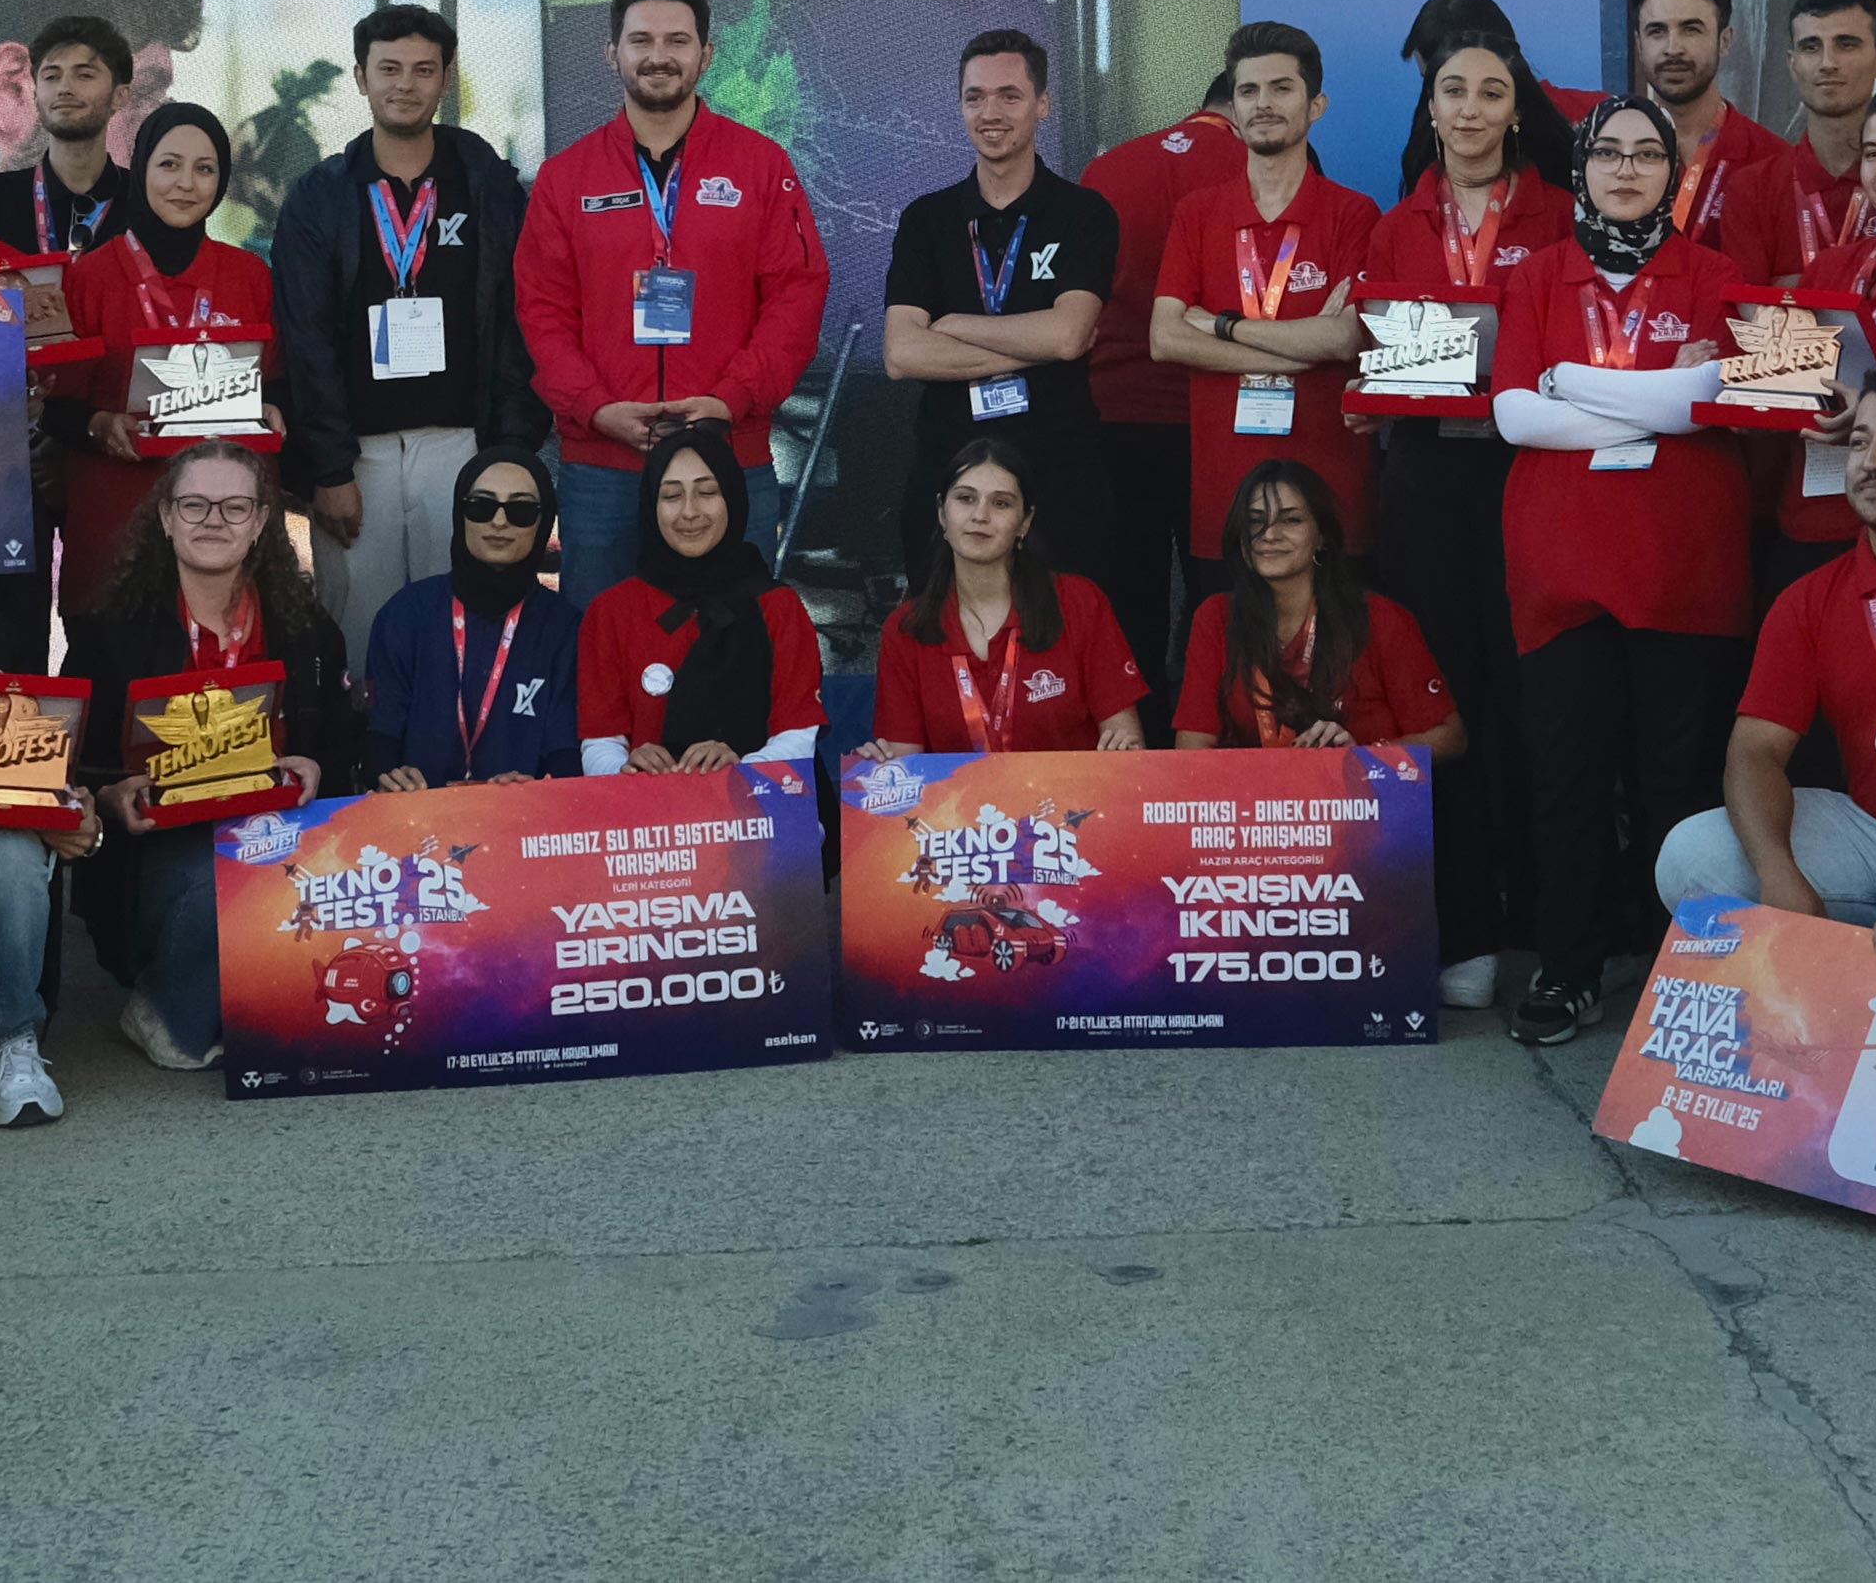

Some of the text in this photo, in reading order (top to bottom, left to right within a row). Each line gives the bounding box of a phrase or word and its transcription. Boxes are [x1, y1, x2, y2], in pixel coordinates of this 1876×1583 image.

[1358, 330, 1478, 376] TEKNOFEST
[1718, 338, 1840, 385] TEKNOFEST
[147, 368, 261, 417] TEKNOFEST
[145, 711, 268, 781] TEKNOFEST
[1309, 799, 1379, 821] OTONOM
[606, 828, 629, 852] SU
[633, 825, 670, 850] ALTI
[915, 821, 1018, 857] TEKNO
[1191, 825, 1332, 849] ARAÇ YARIŞMASI
[294, 861, 401, 903] TEKNO
[1161, 874, 1364, 907] YARIŞMA
[550, 890, 757, 934] YARIŞMA
[1670, 938, 1741, 954] TEKNOFEST
[1167, 951, 1362, 983] 175.000
[550, 967, 765, 1016] 250.000
[1649, 995, 1737, 1040] HAVA
[1674, 1062, 1785, 1098] YARIŞMALARI
